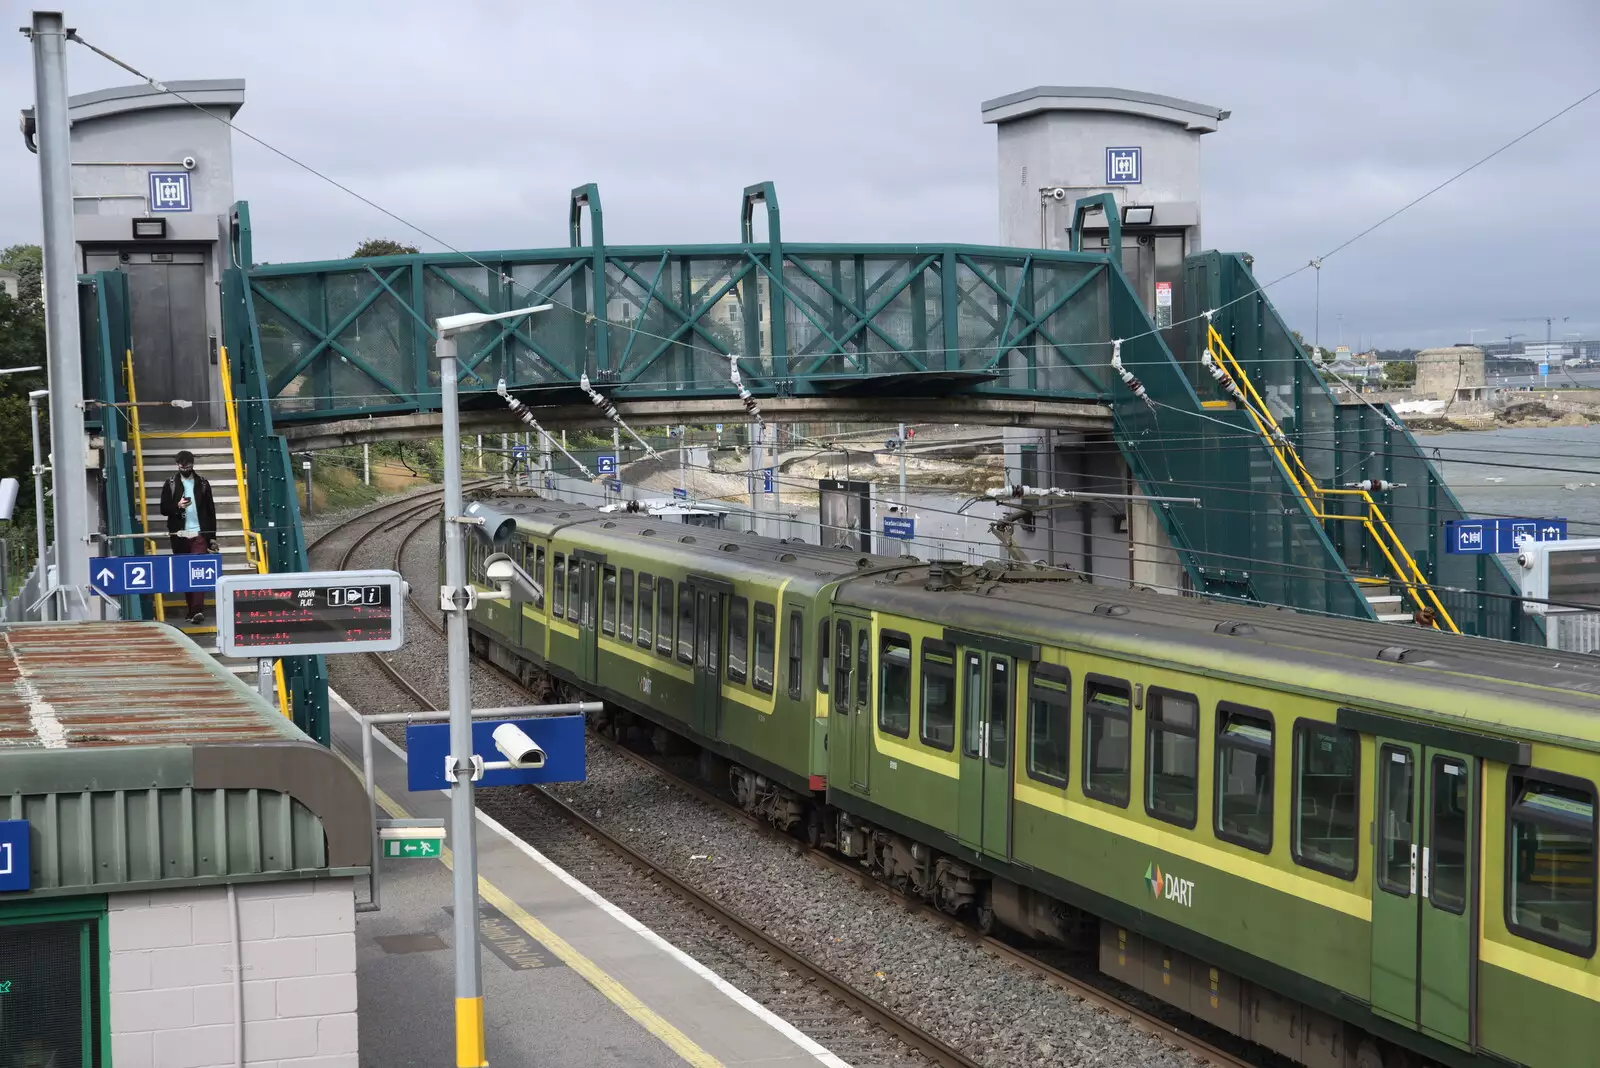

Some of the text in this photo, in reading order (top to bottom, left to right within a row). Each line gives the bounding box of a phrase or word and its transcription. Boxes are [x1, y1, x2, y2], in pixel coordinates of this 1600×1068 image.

[603, 460, 611, 470] 2
[131, 566, 146, 585] 2
[297, 587, 316, 598] ARDÁN
[332, 589, 340, 604] 1
[299, 599, 314, 607] PLAT.
[1165, 873, 1195, 908] DART
[508, 953, 545, 968] Line
